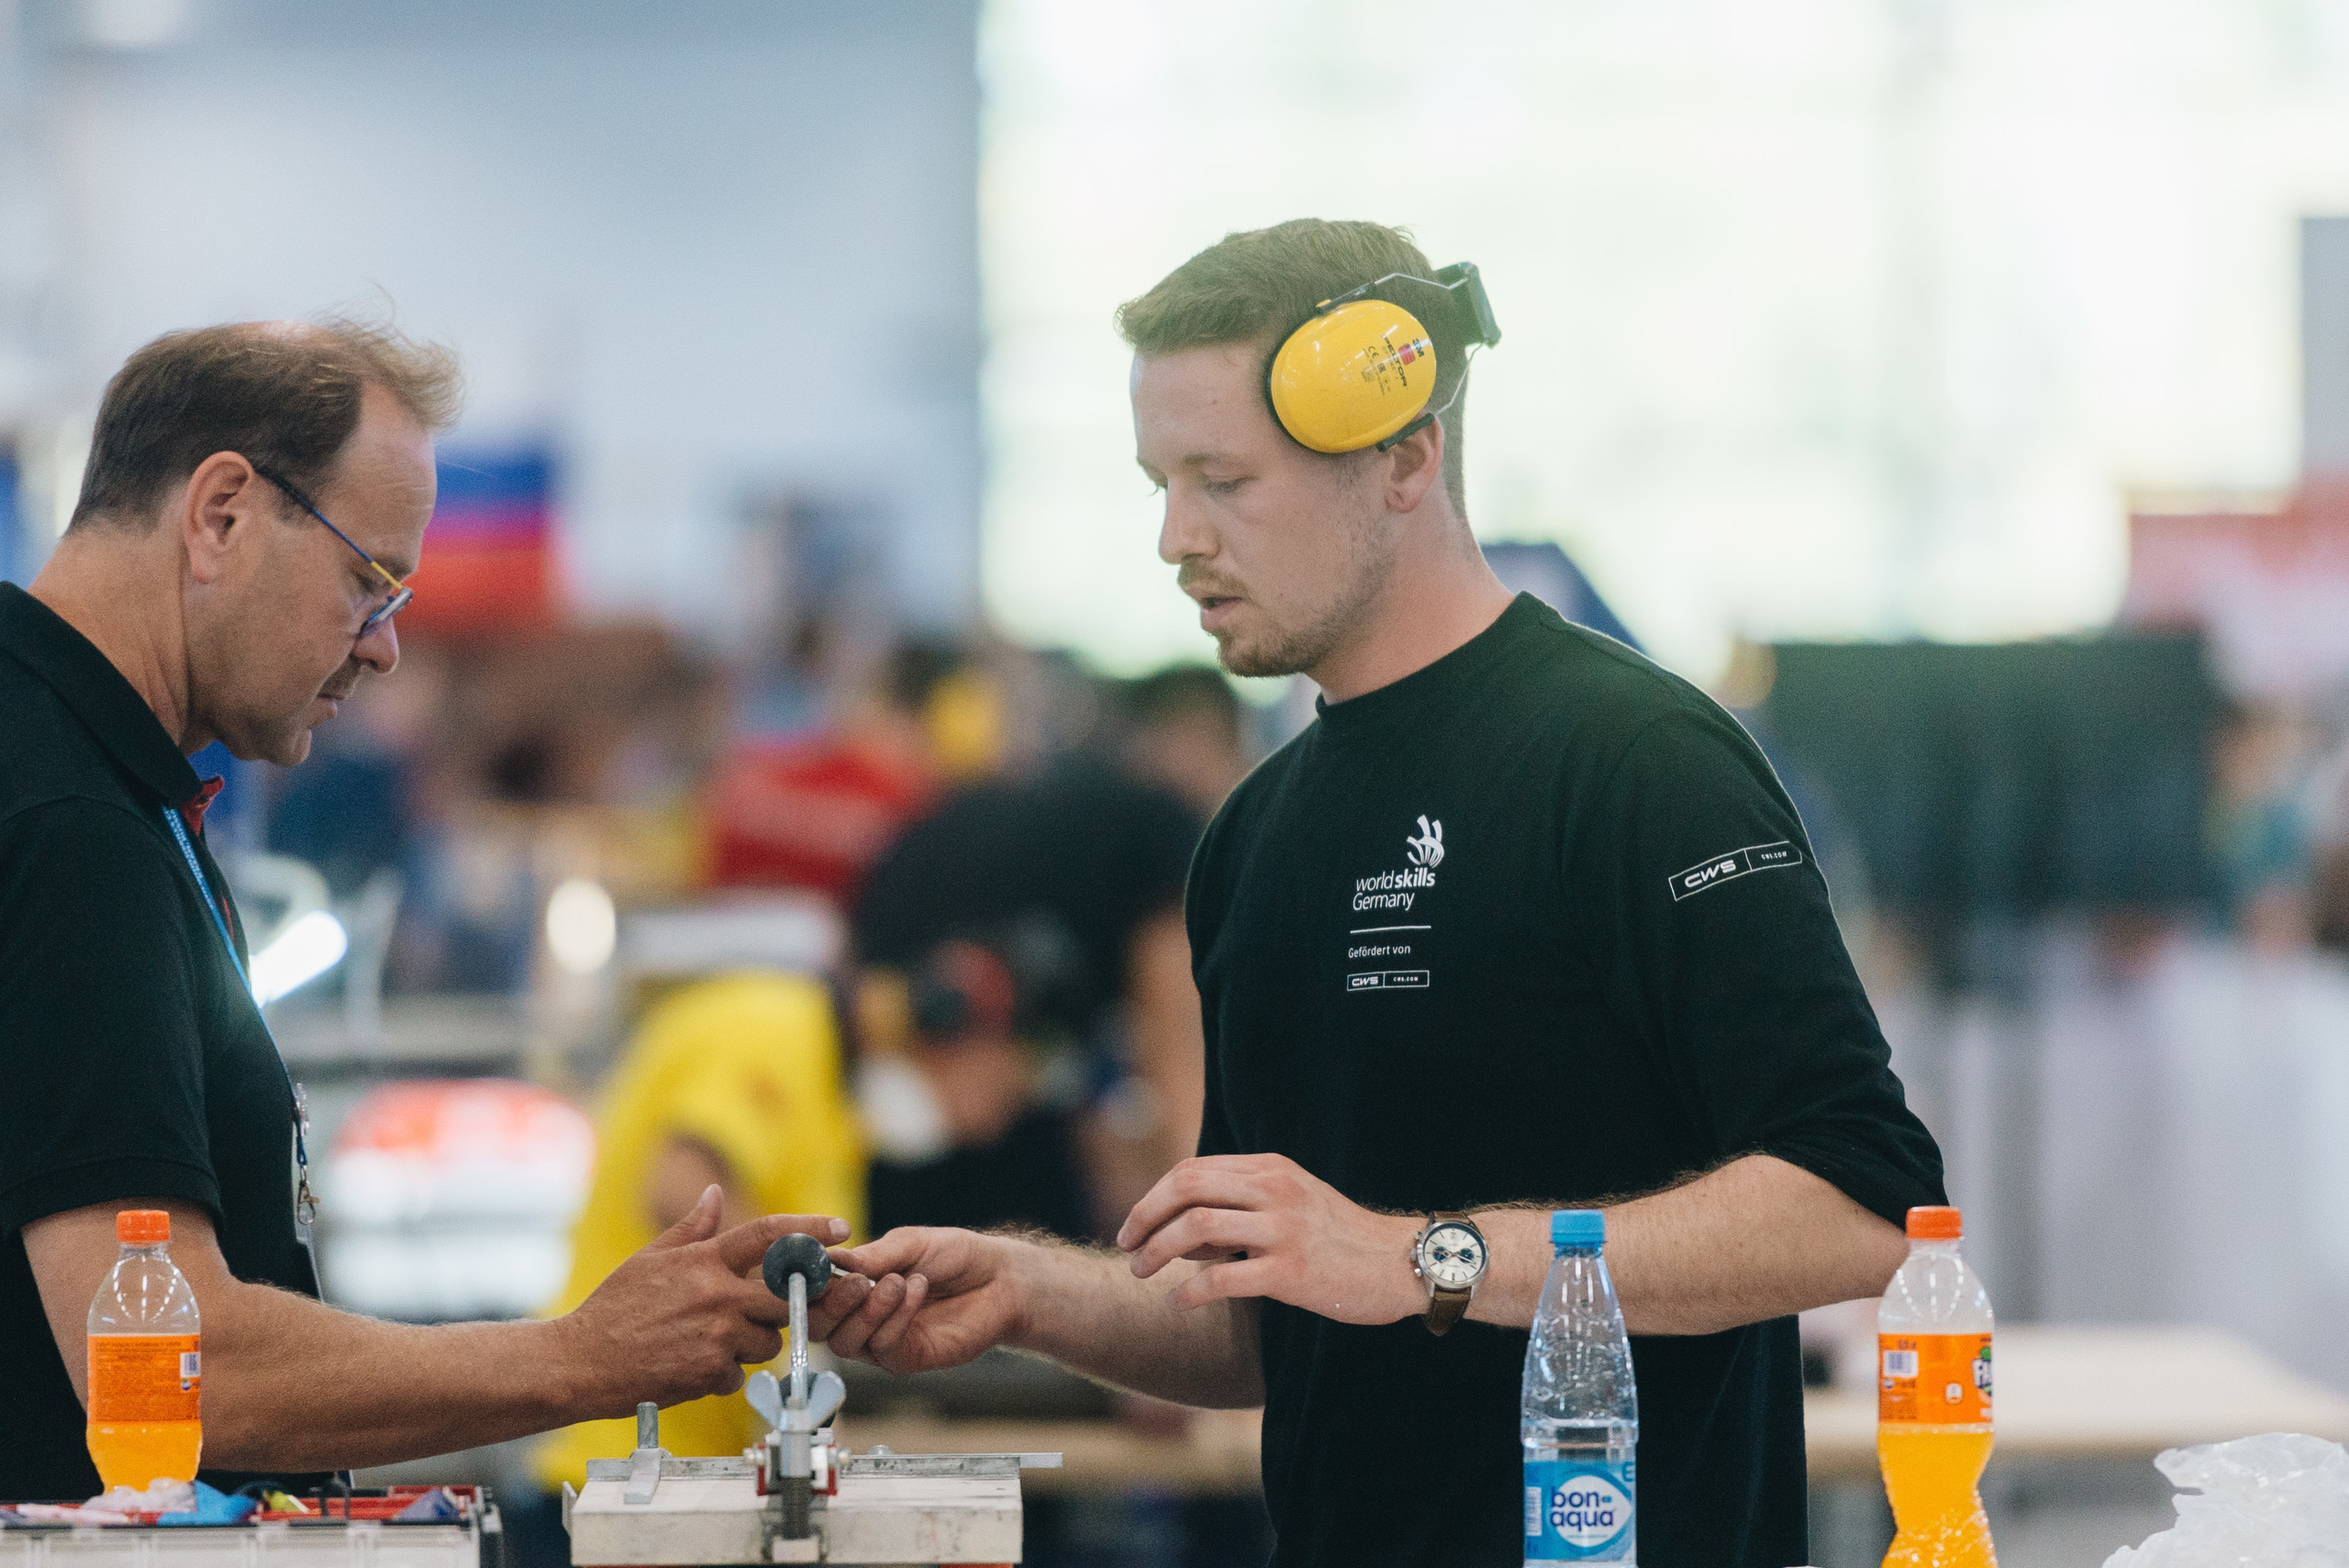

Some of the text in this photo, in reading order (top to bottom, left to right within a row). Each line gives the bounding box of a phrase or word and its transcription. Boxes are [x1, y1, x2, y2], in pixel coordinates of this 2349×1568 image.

[1412, 338, 1424, 357] 3M
[1685, 860, 1736, 888] CWS
[1353, 893, 1415, 911] Germany
[1348, 945, 1410, 959] Gefördert von
[1352, 976, 1379, 987] CWS
[1551, 1510, 1614, 1532] aqua
